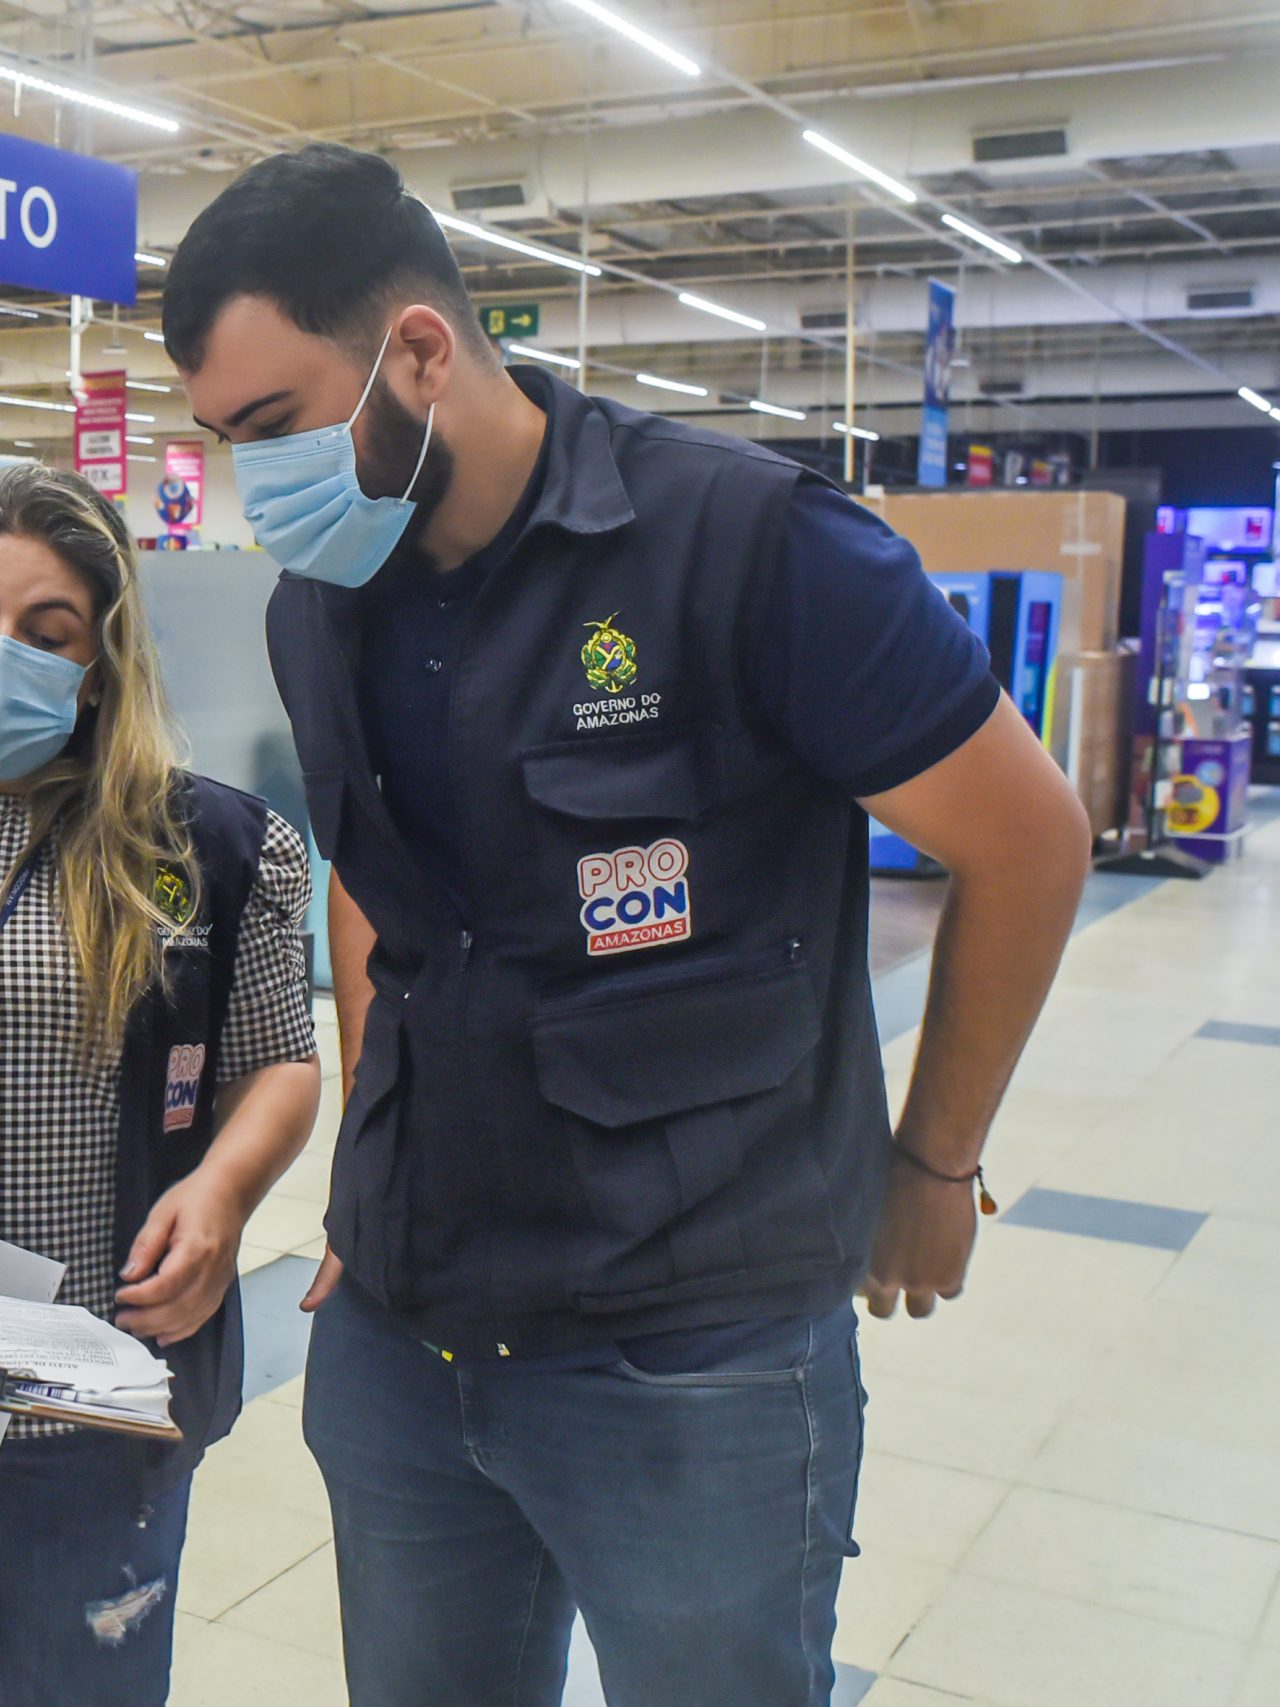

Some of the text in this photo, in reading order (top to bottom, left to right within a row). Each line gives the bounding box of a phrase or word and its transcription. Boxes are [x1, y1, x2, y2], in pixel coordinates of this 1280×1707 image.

[573, 692, 661, 716] GOVERNO DO
[576, 707, 659, 731] AMAZONAS
[580, 841, 685, 897] PRO
[584, 881, 686, 931] CON
[594, 920, 684, 949] AMAZONAS
[168, 1046, 203, 1078] PRO
[165, 1080, 197, 1109] CON
